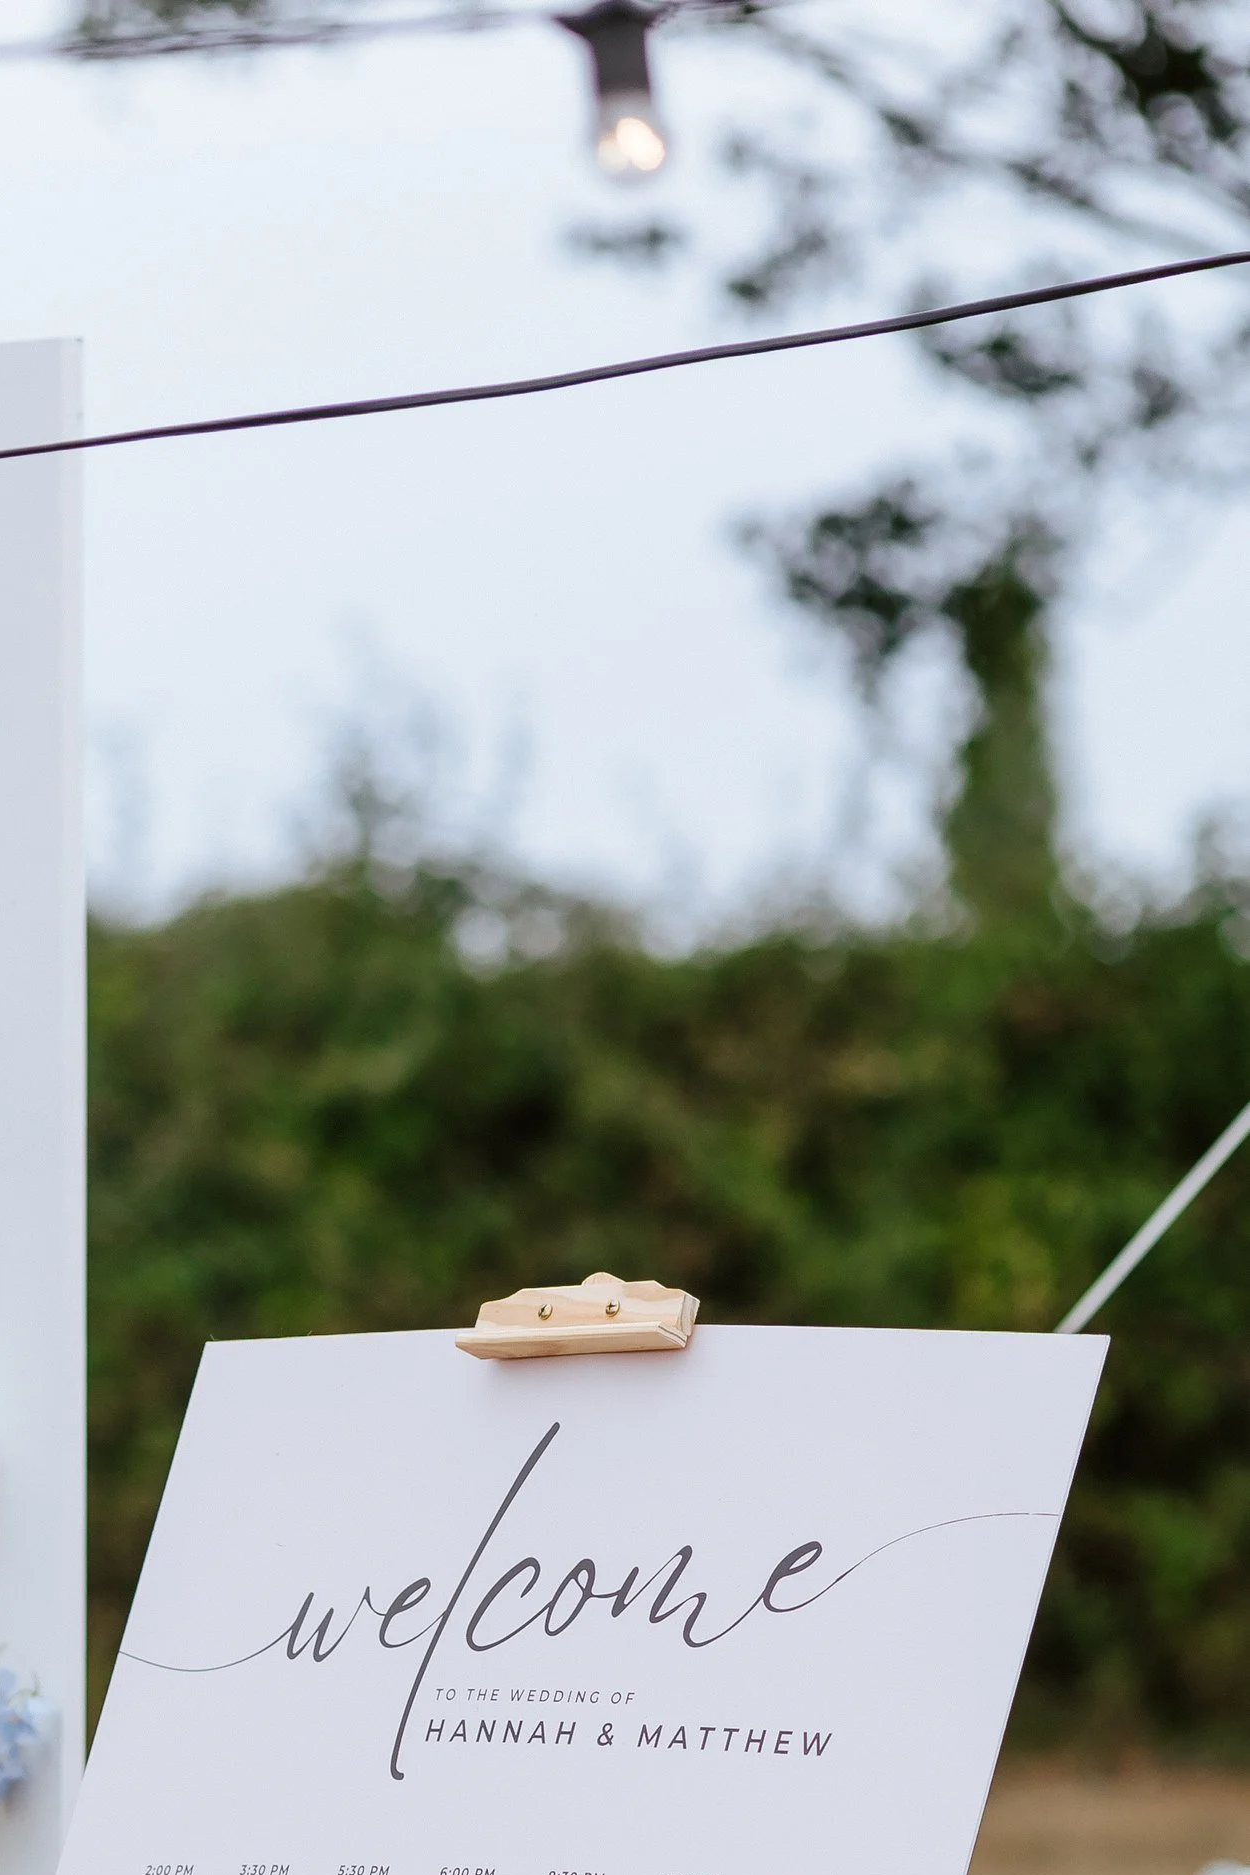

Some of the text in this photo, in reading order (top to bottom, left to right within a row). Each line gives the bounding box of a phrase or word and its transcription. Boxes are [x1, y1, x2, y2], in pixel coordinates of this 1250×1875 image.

[272, 1421, 855, 1781] welcome
[435, 1688, 636, 1705] TO THE WEDDING OF
[424, 1718, 833, 1757] HANNAH & MATTHEW
[174, 1864, 195, 1875] PM
[239, 1864, 290, 1875] 3:30 PM
